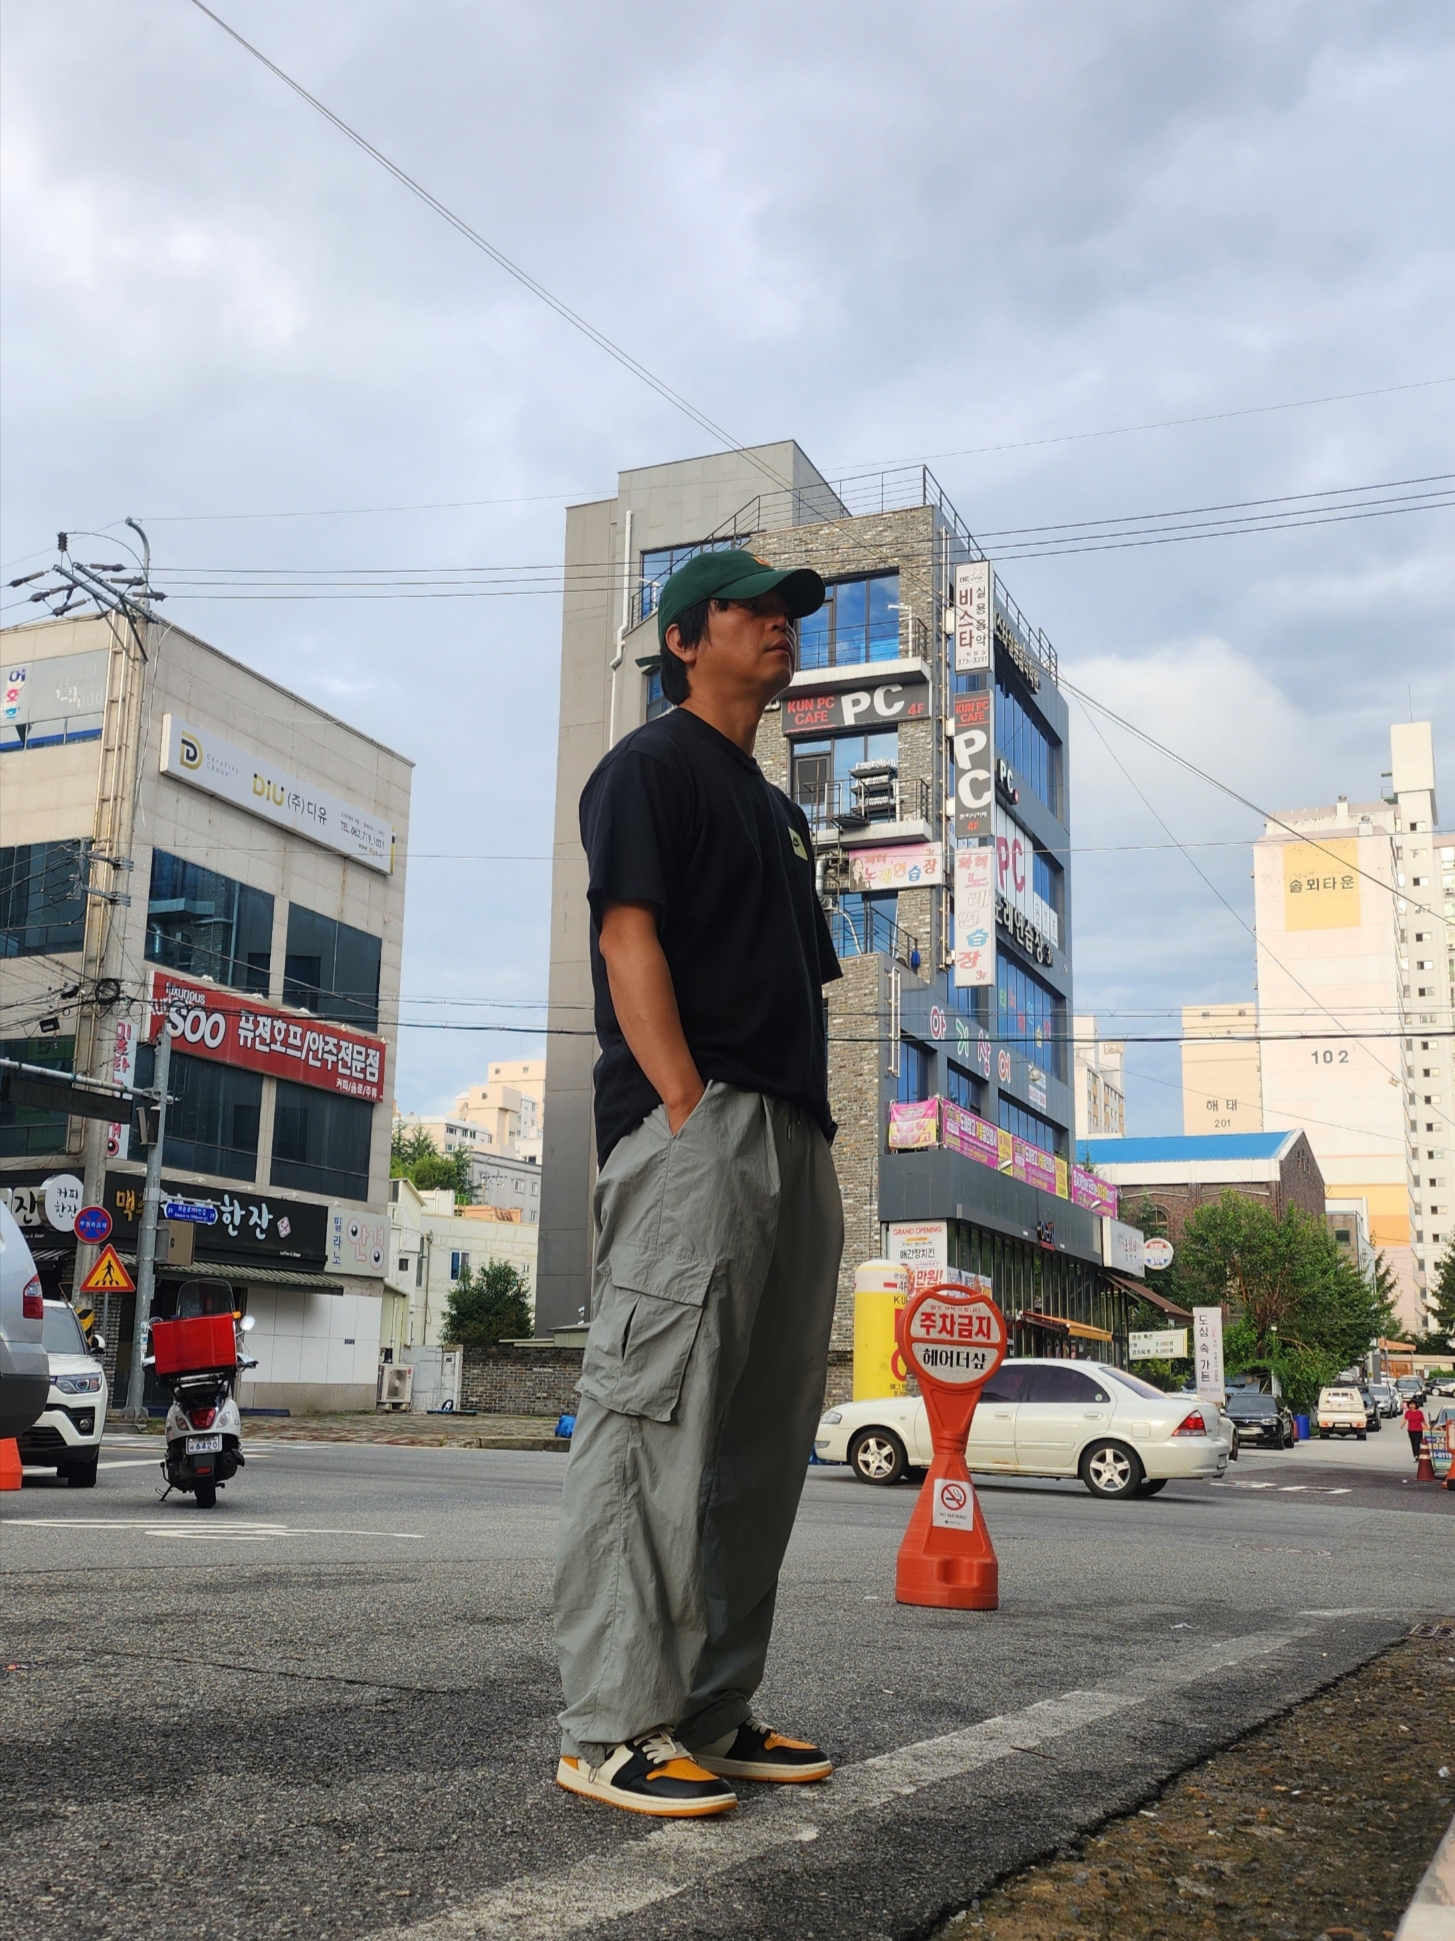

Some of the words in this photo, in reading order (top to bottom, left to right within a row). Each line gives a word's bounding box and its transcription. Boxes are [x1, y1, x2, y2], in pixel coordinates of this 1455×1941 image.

[959, 588, 974, 648] 비스타
[787, 699, 814, 713] KUN
[817, 697, 834, 709] PC
[841, 683, 905, 726] PC
[907, 702, 925, 716] 4F
[955, 703, 974, 714] KUN
[976, 700, 990, 710] PC
[795, 711, 828, 725] CAFE
[960, 711, 985, 723] CAFE
[206, 754, 240, 775] CREATIVE
[206, 762, 229, 778] GROUP
[1000, 759, 1014, 794] PC
[996, 836, 1026, 893] PC
[1289, 875, 1355, 893] 솔뫼타운
[975, 970, 989, 981] 3F
[165, 982, 206, 1005] luxurious
[166, 1000, 227, 1050] SOO
[1311, 1050, 1350, 1065] 102
[1214, 1119, 1231, 1128] 201
[56, 1187, 79, 1200] 커피
[54, 1200, 80, 1220] 한잔
[219, 1193, 274, 1240] 한잔
[893, 1228, 915, 1236] GRAND
[915, 1226, 942, 1235] OPENING
[332, 1216, 342, 1267] 밀라노
[347, 1217, 385, 1271] 안경
[916, 1270, 943, 1287] 만원!
[920, 1311, 991, 1340] 주차금지
[923, 1348, 987, 1370] 헤어더샵
[196, 1441, 218, 1450] 6420
